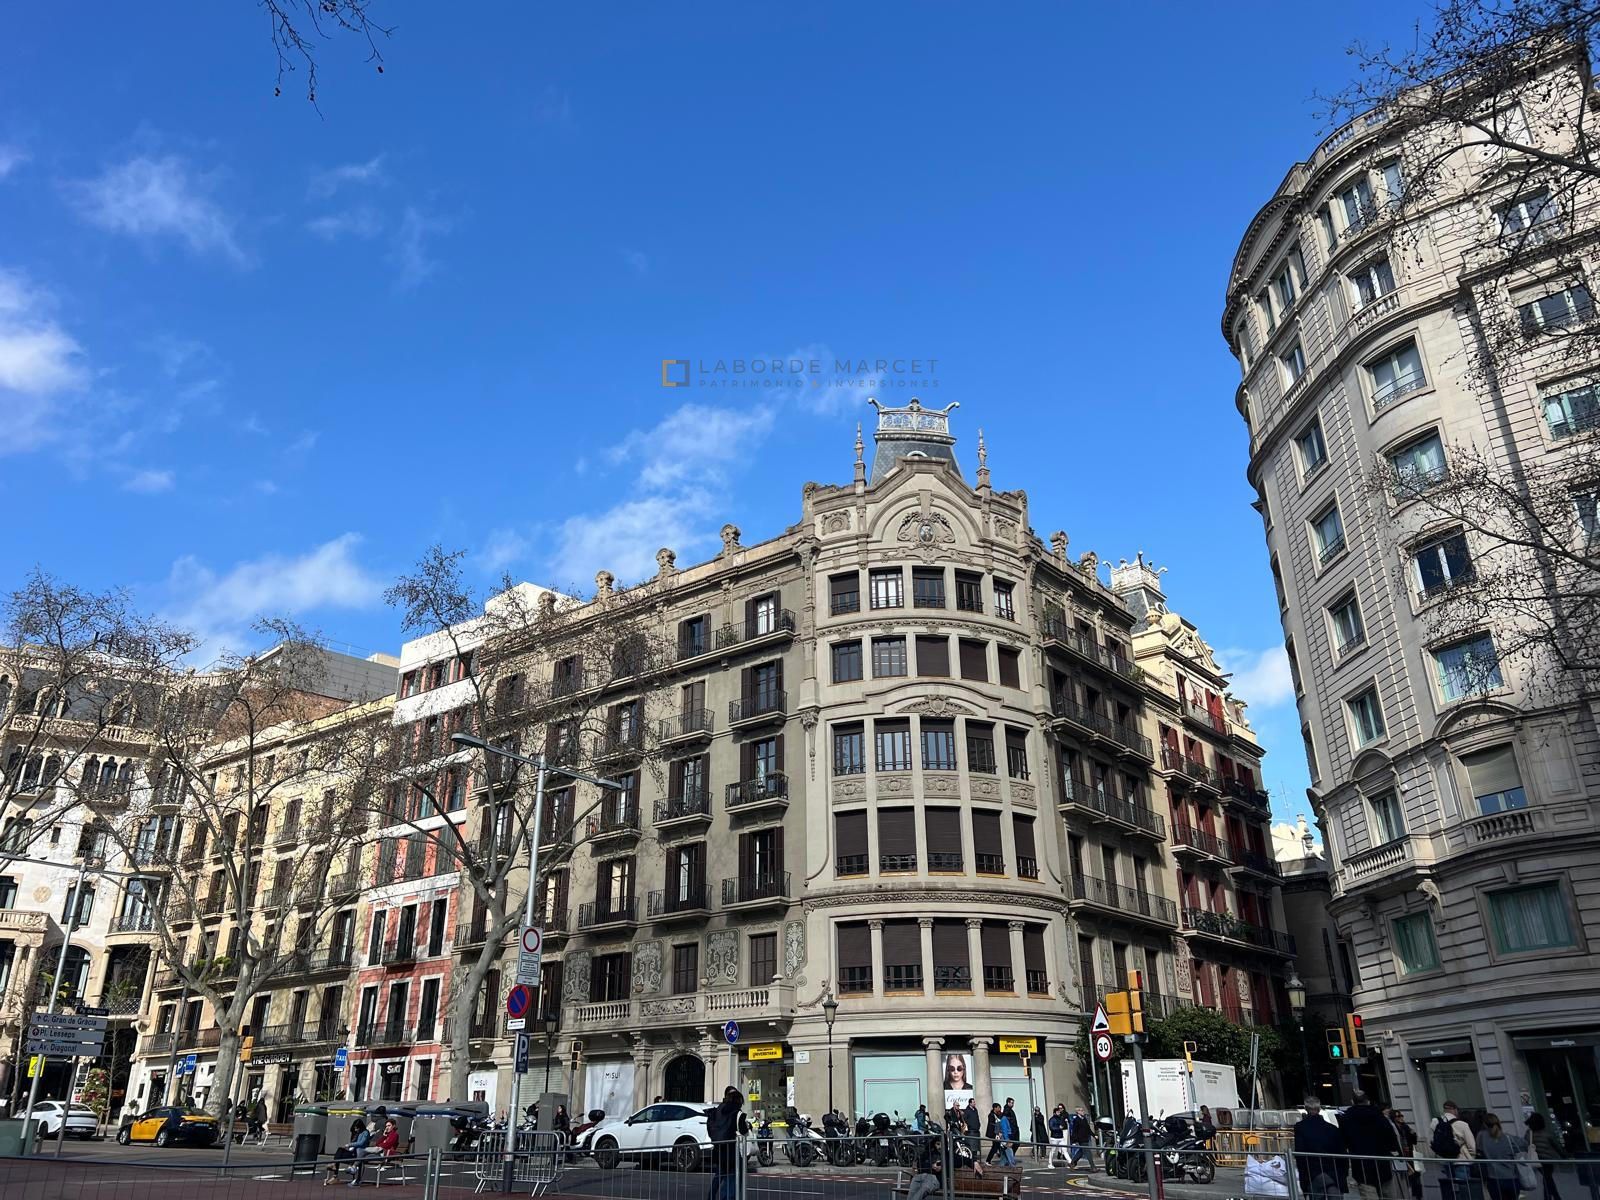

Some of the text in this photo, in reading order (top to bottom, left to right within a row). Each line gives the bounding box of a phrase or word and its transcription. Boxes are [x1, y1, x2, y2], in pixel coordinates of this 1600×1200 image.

[52, 1016, 66, 1024] Gran
[50, 1030, 75, 1038] Lesseps
[51, 1044, 76, 1053] Diagonal
[1098, 1043, 1108, 1052] 30
[252, 1053, 290, 1064] THE GARDEN
